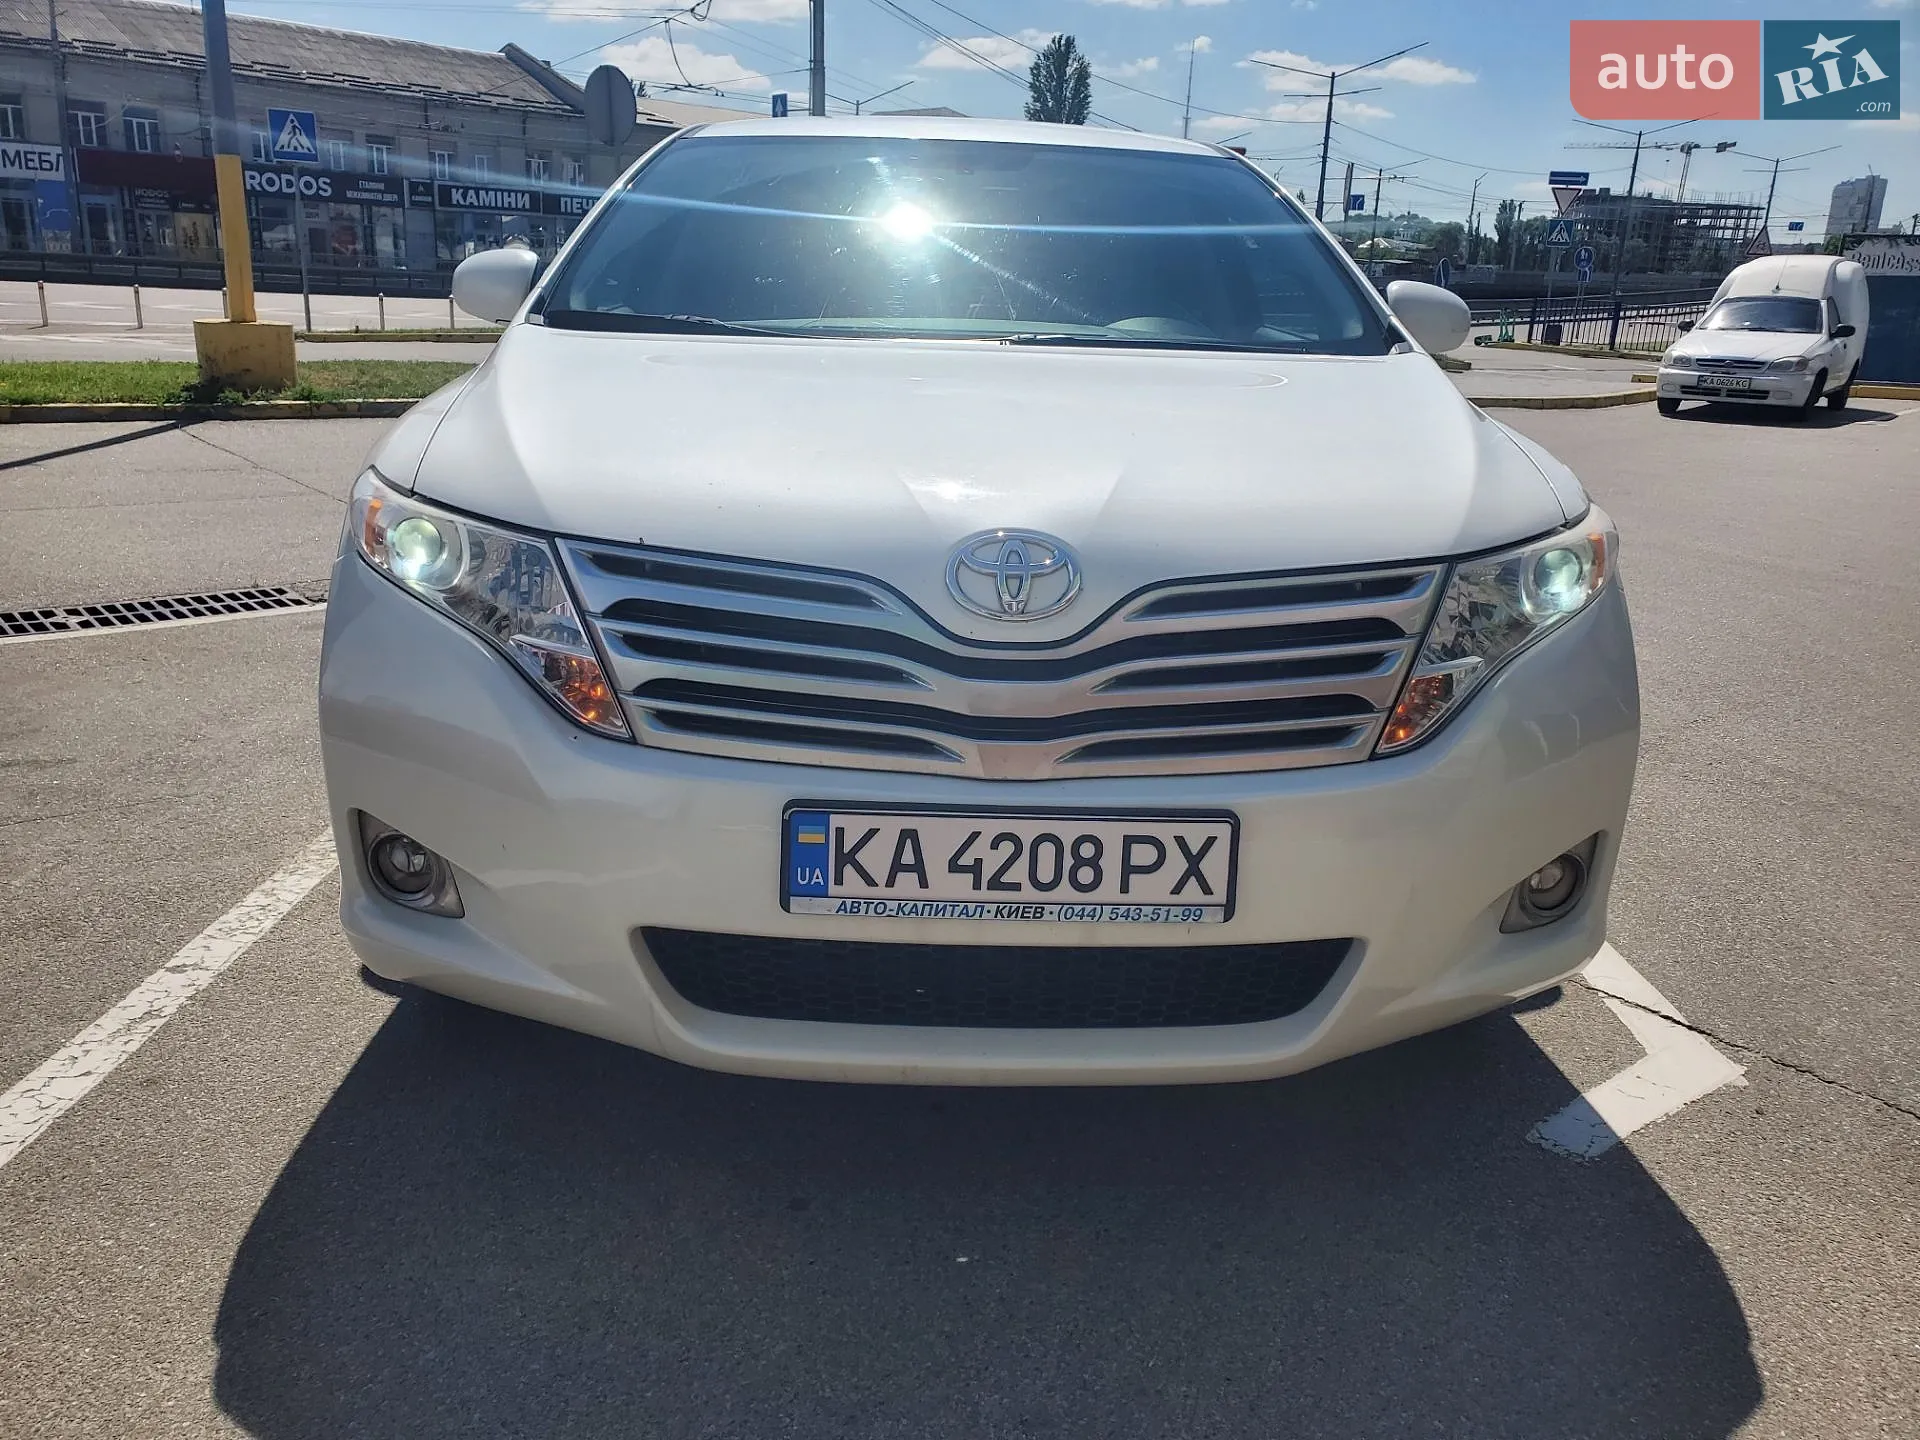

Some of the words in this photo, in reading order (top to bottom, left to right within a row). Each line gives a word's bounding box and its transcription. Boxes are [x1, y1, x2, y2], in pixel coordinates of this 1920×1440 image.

[244, 170, 332, 197] RODOS
[451, 188, 530, 209] КАМІНИ
[560, 197, 599, 214] ПЕЧ
[1703, 377, 1714, 385] KA
[833, 827, 929, 889] KA
[947, 831, 1104, 894] 4208
[1120, 835, 1218, 895] PX
[797, 867, 825, 886] UA
[835, 900, 984, 918] АВТО-КАПИТАЛ
[994, 905, 1045, 920] КИЕВ
[1057, 905, 1104, 922] (044)
[1109, 906, 1203, 922] 543-51-99
